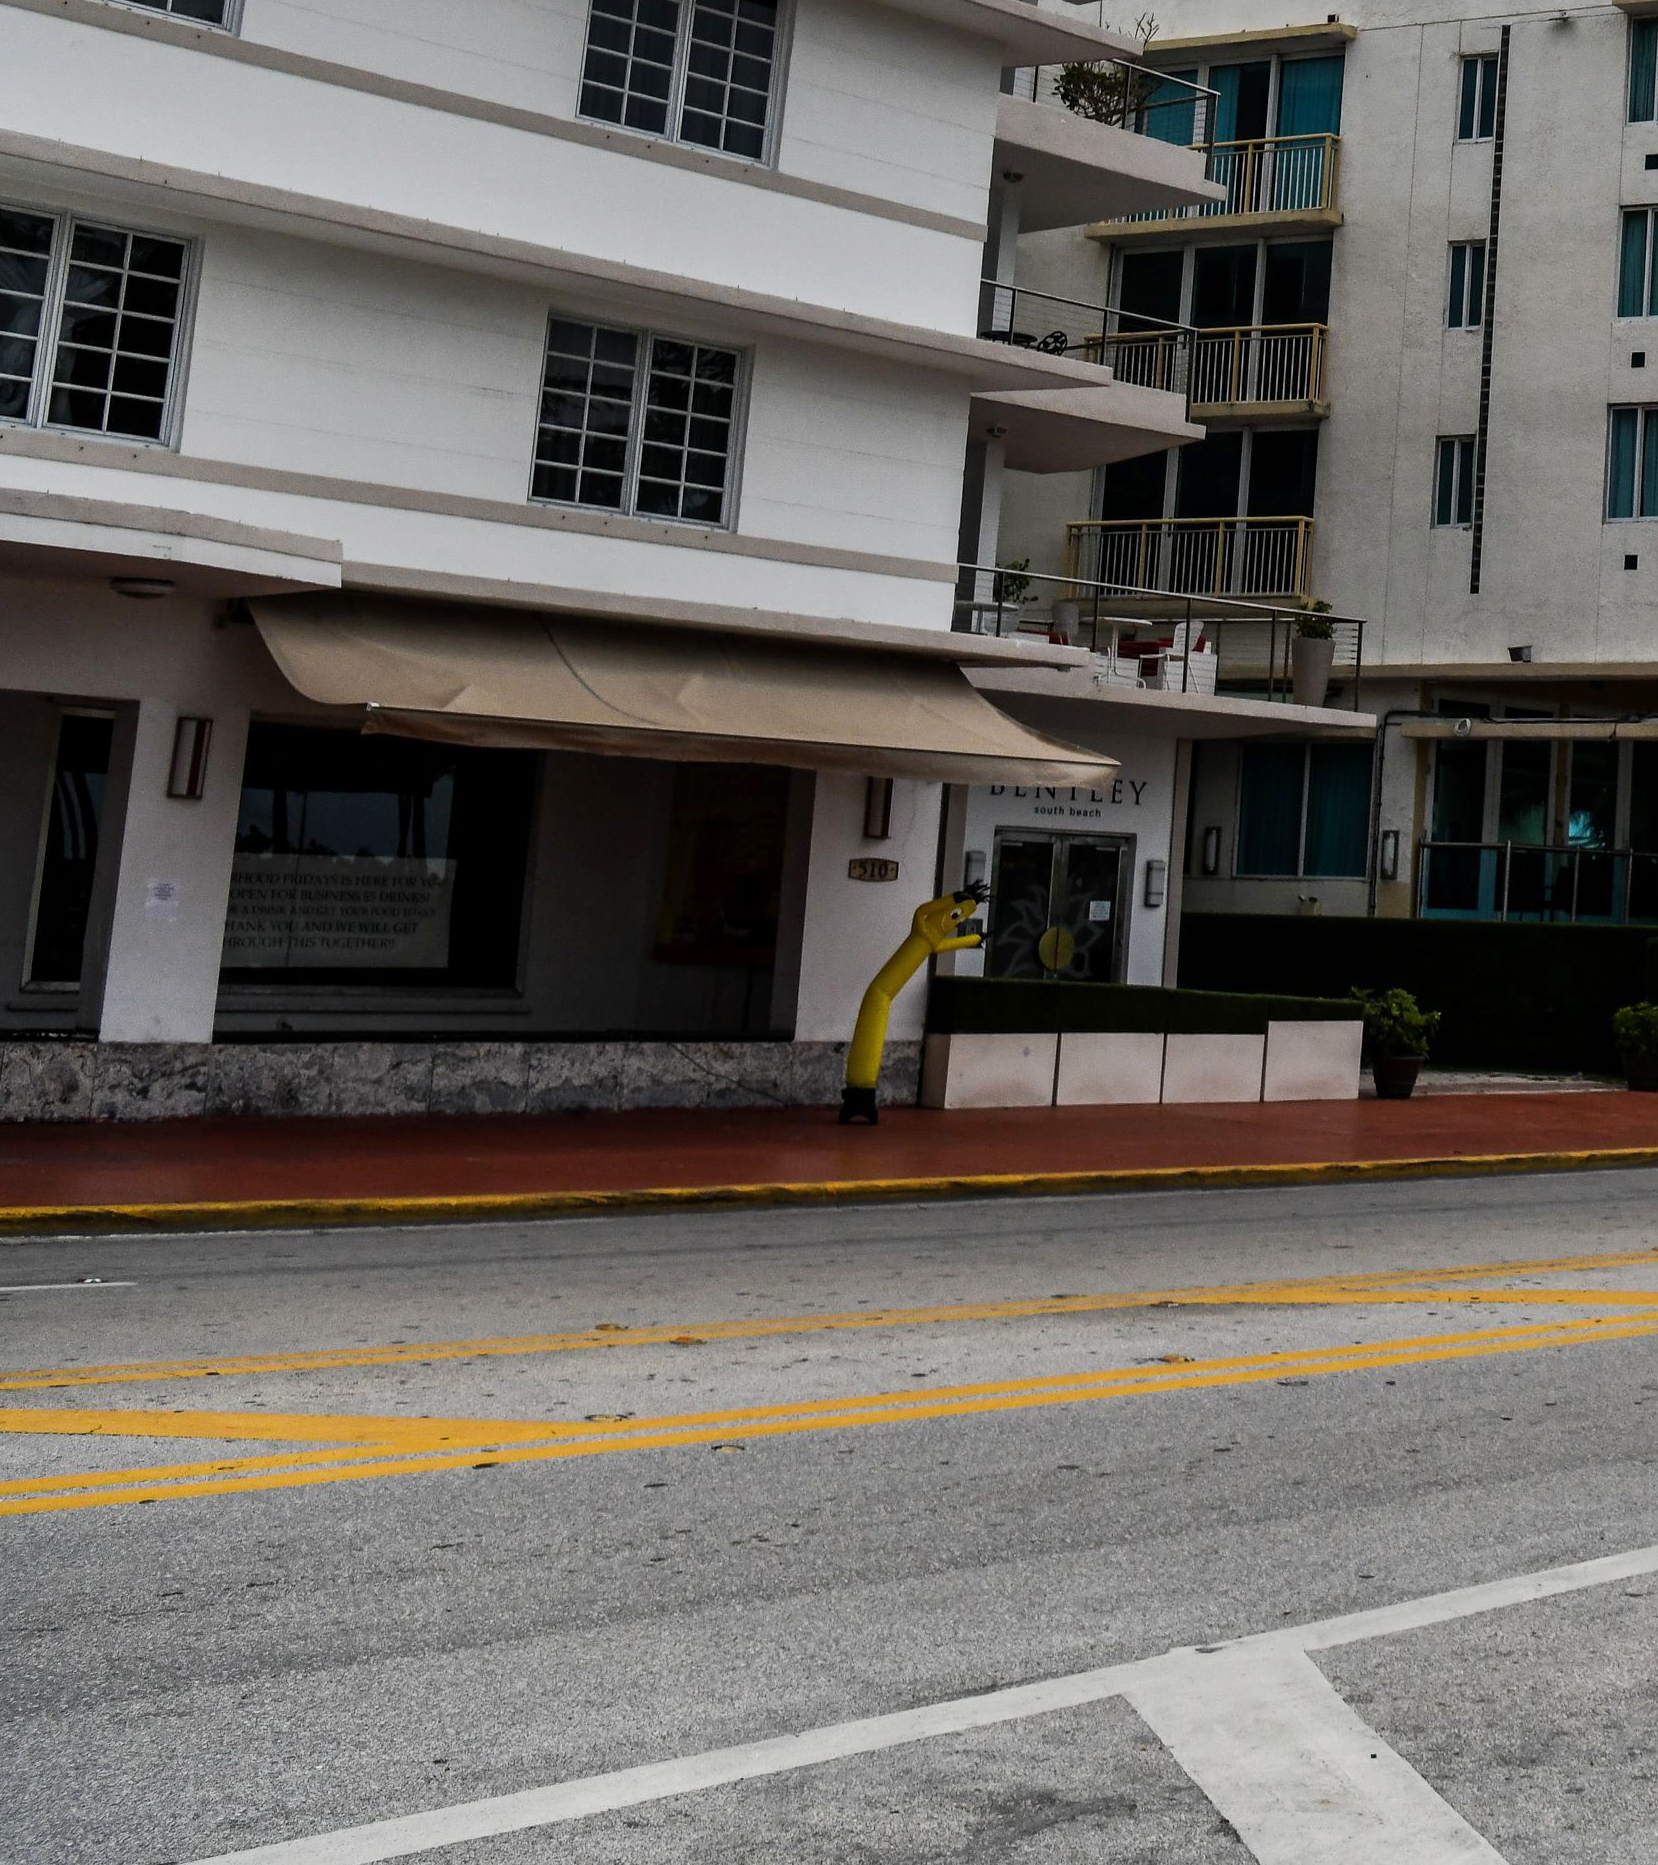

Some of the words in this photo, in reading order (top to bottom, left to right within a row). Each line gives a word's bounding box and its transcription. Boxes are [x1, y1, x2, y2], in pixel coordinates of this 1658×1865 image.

[1034, 805, 1065, 816] south
[1069, 807, 1102, 818] beach
[858, 861, 888, 879] 510
